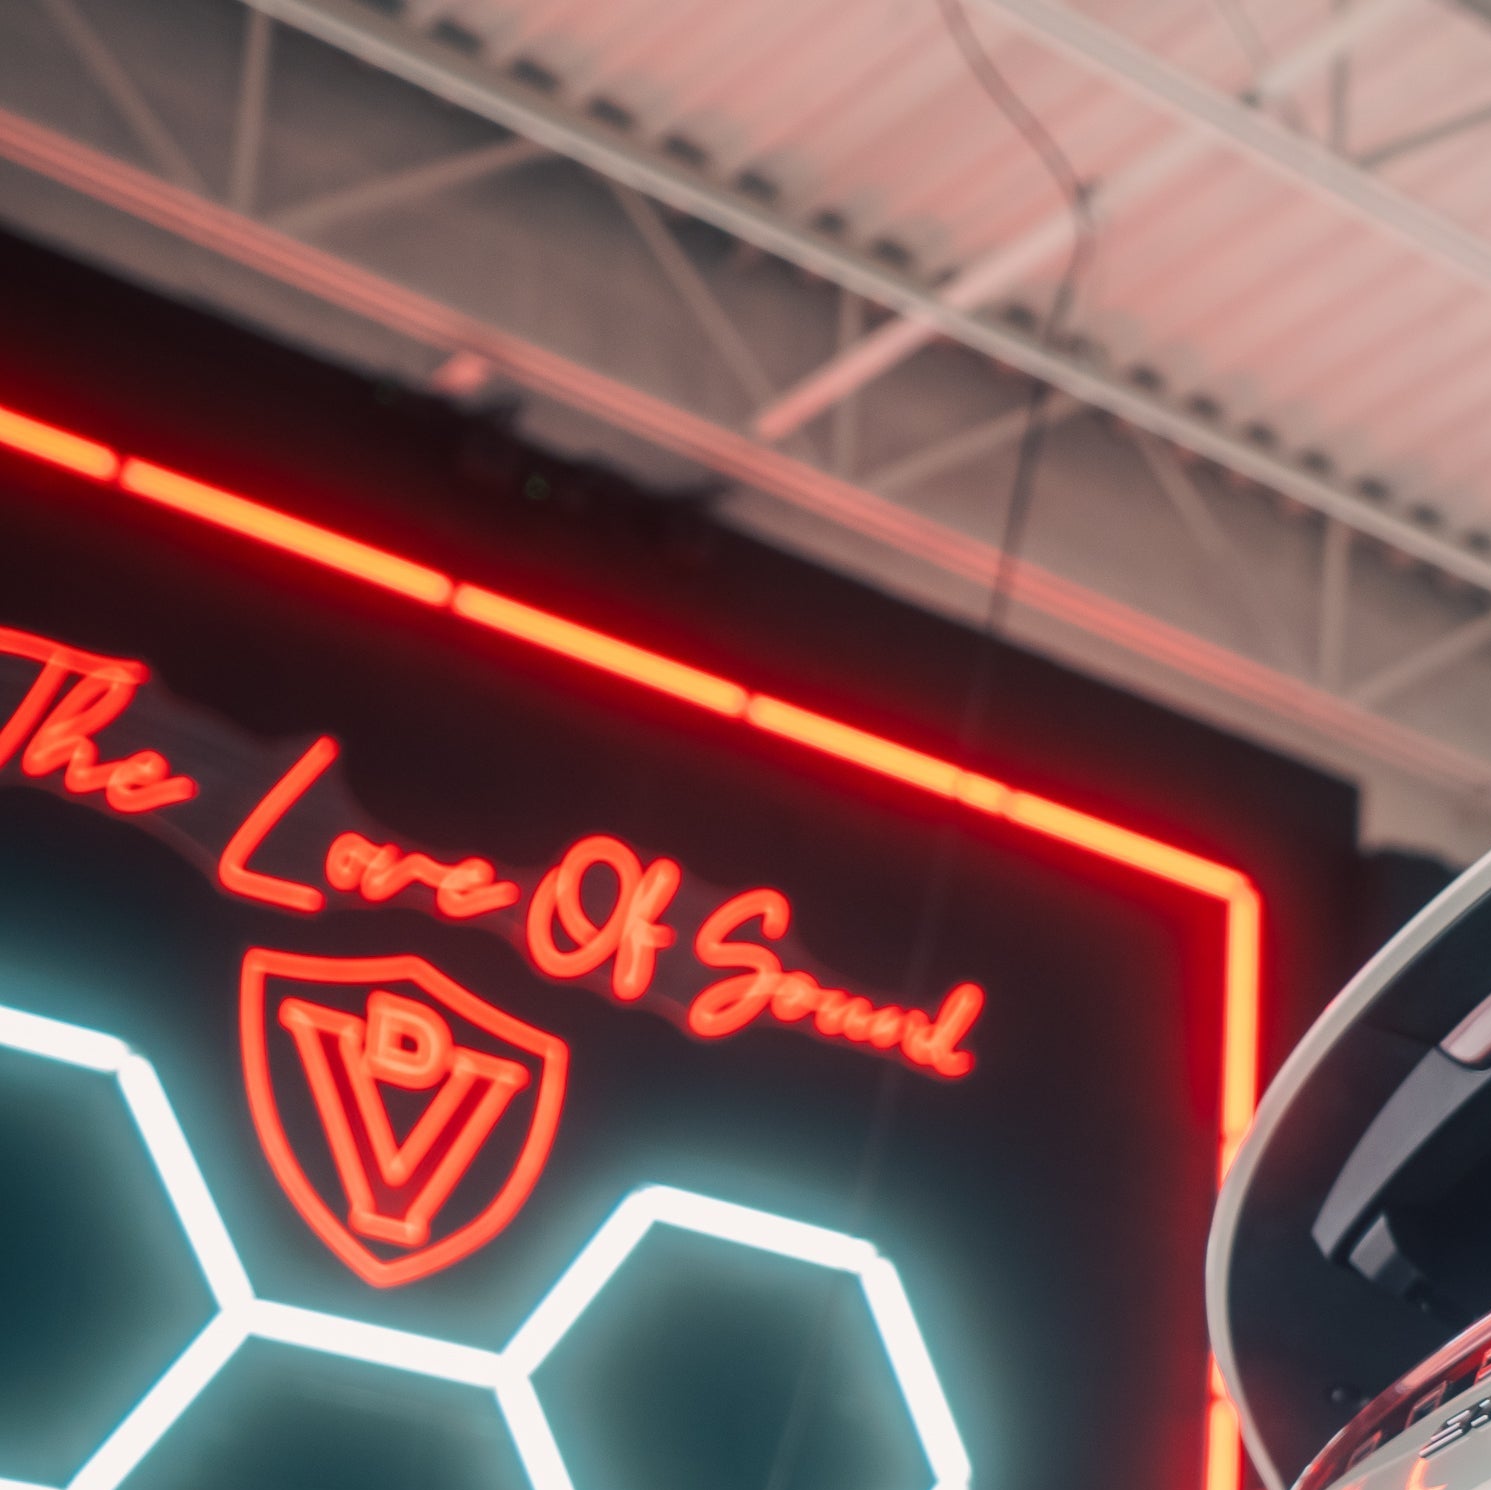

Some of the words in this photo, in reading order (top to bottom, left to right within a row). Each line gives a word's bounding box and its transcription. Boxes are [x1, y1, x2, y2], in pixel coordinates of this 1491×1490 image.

[0, 626, 197, 813] The
[218, 735, 521, 919] Love
[525, 834, 681, 1002] Of
[687, 888, 985, 1077] Sound
